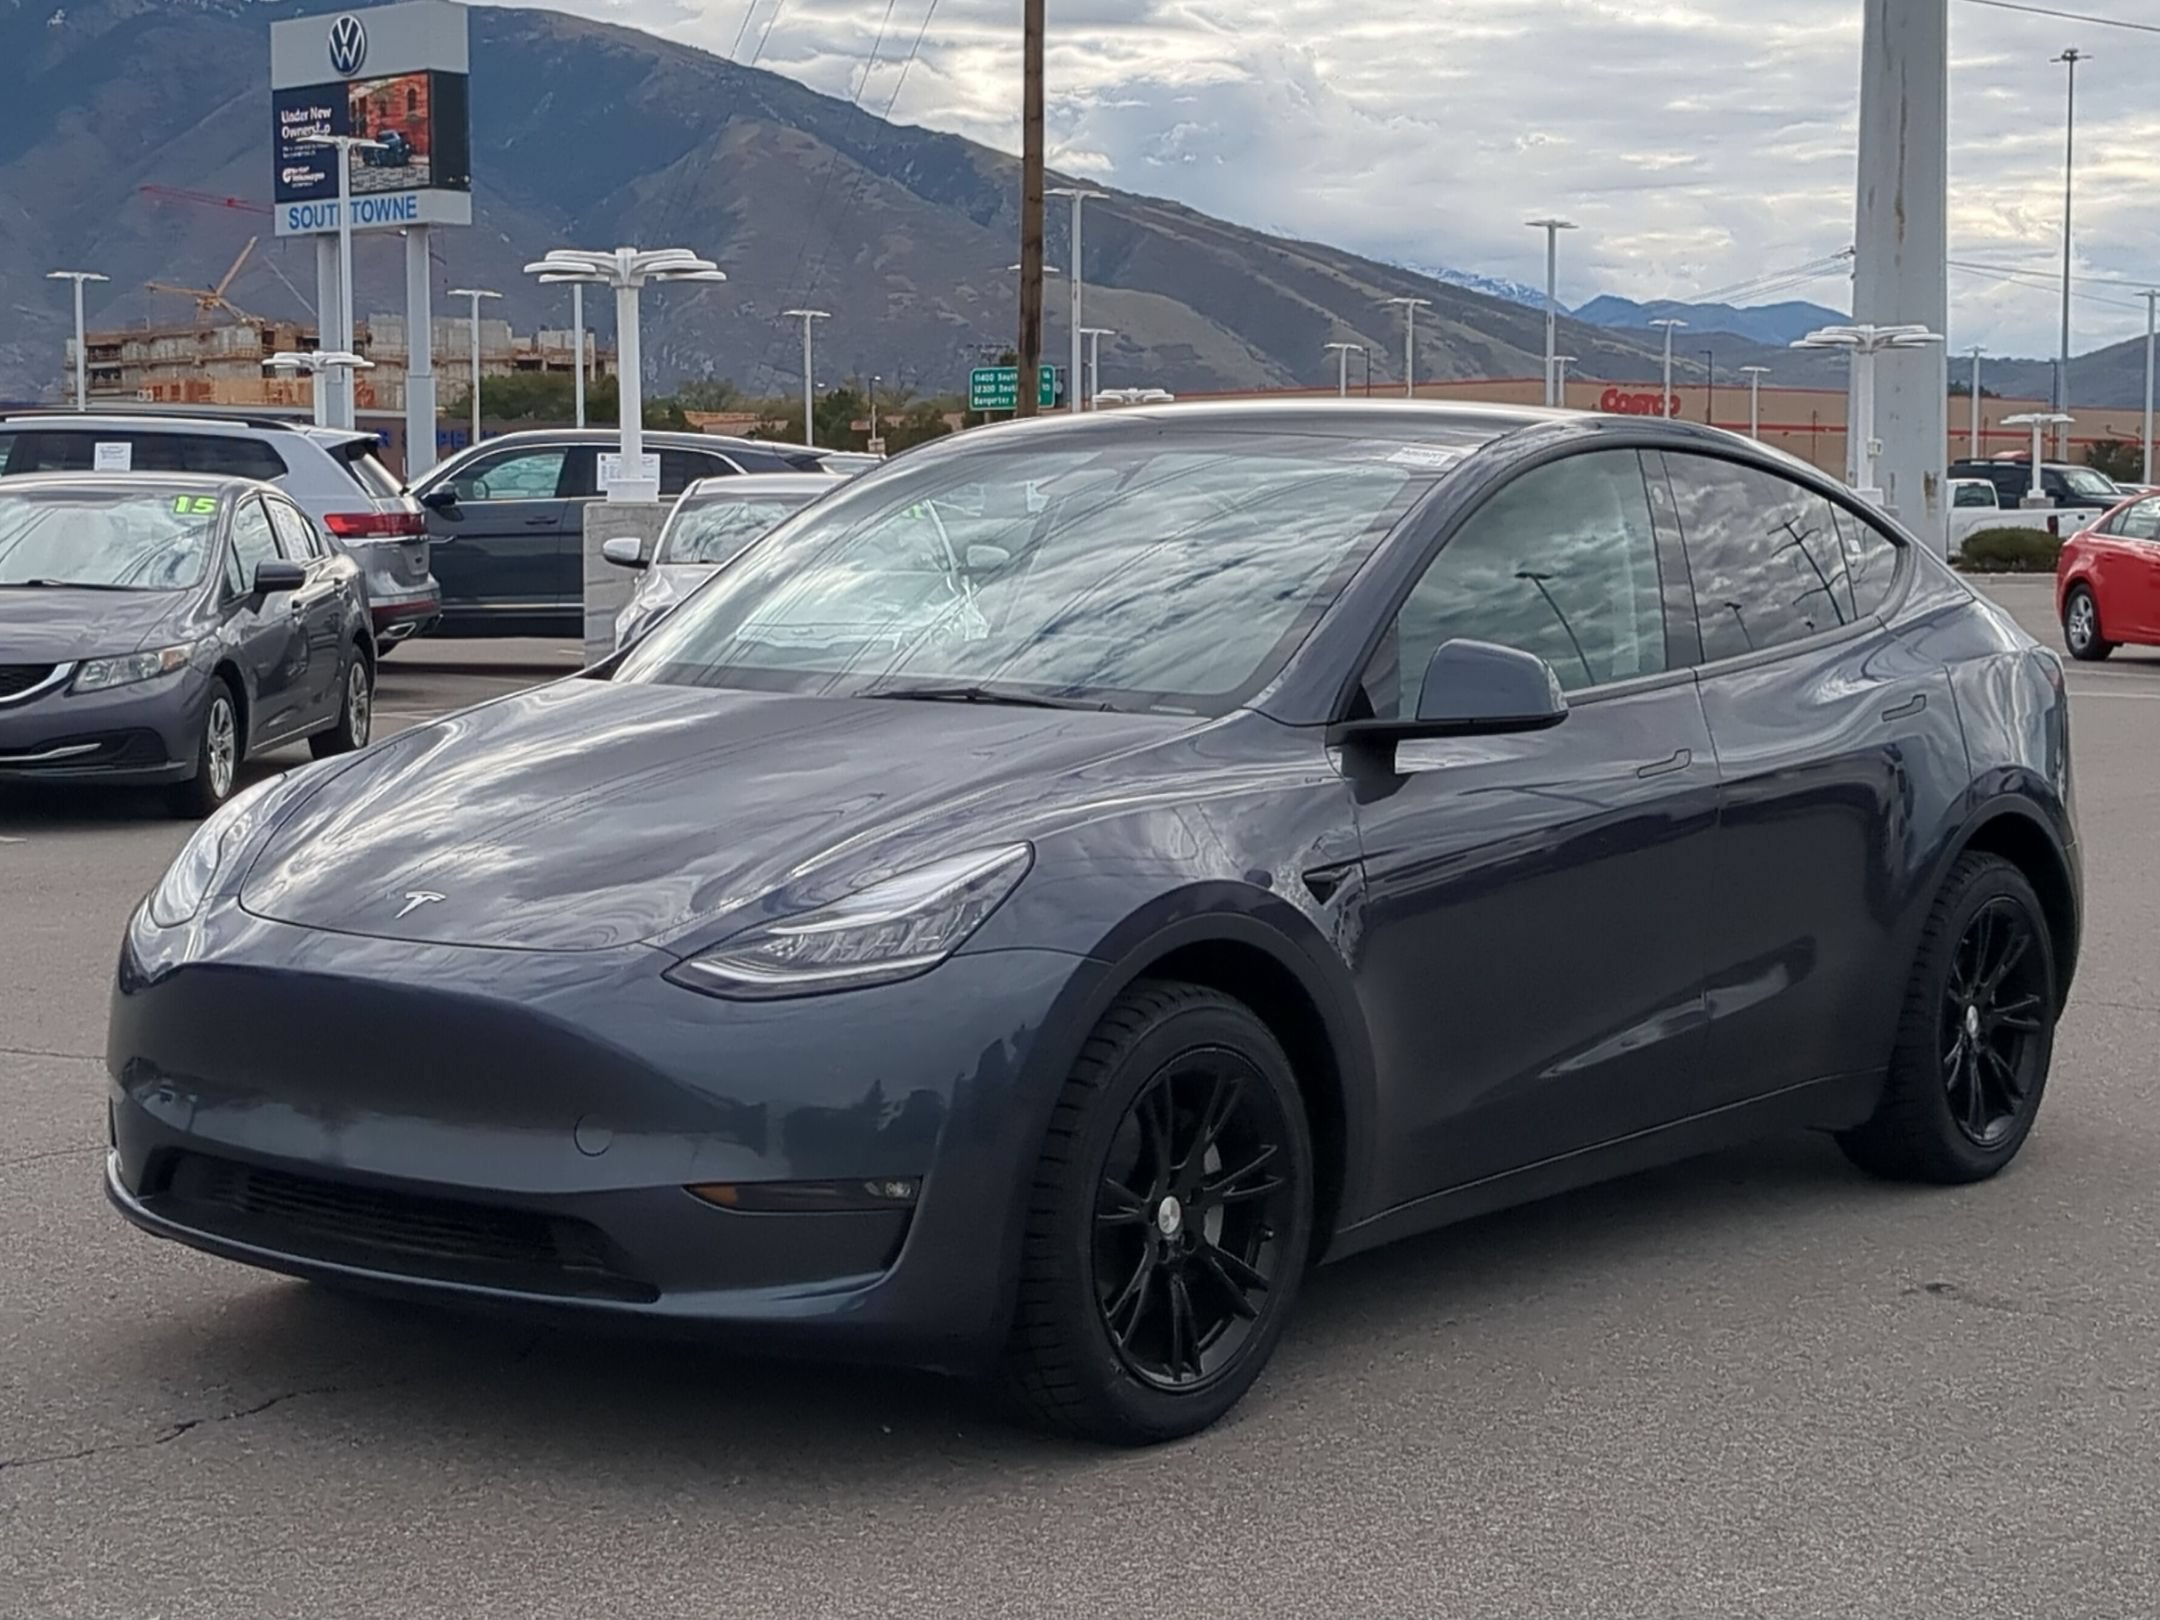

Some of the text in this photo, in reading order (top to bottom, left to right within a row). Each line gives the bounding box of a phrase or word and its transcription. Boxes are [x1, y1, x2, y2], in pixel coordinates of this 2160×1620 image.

[281, 106, 332, 124] Under New
[288, 195, 417, 230] SOUTTOWNE
[175, 495, 217, 514] 15
